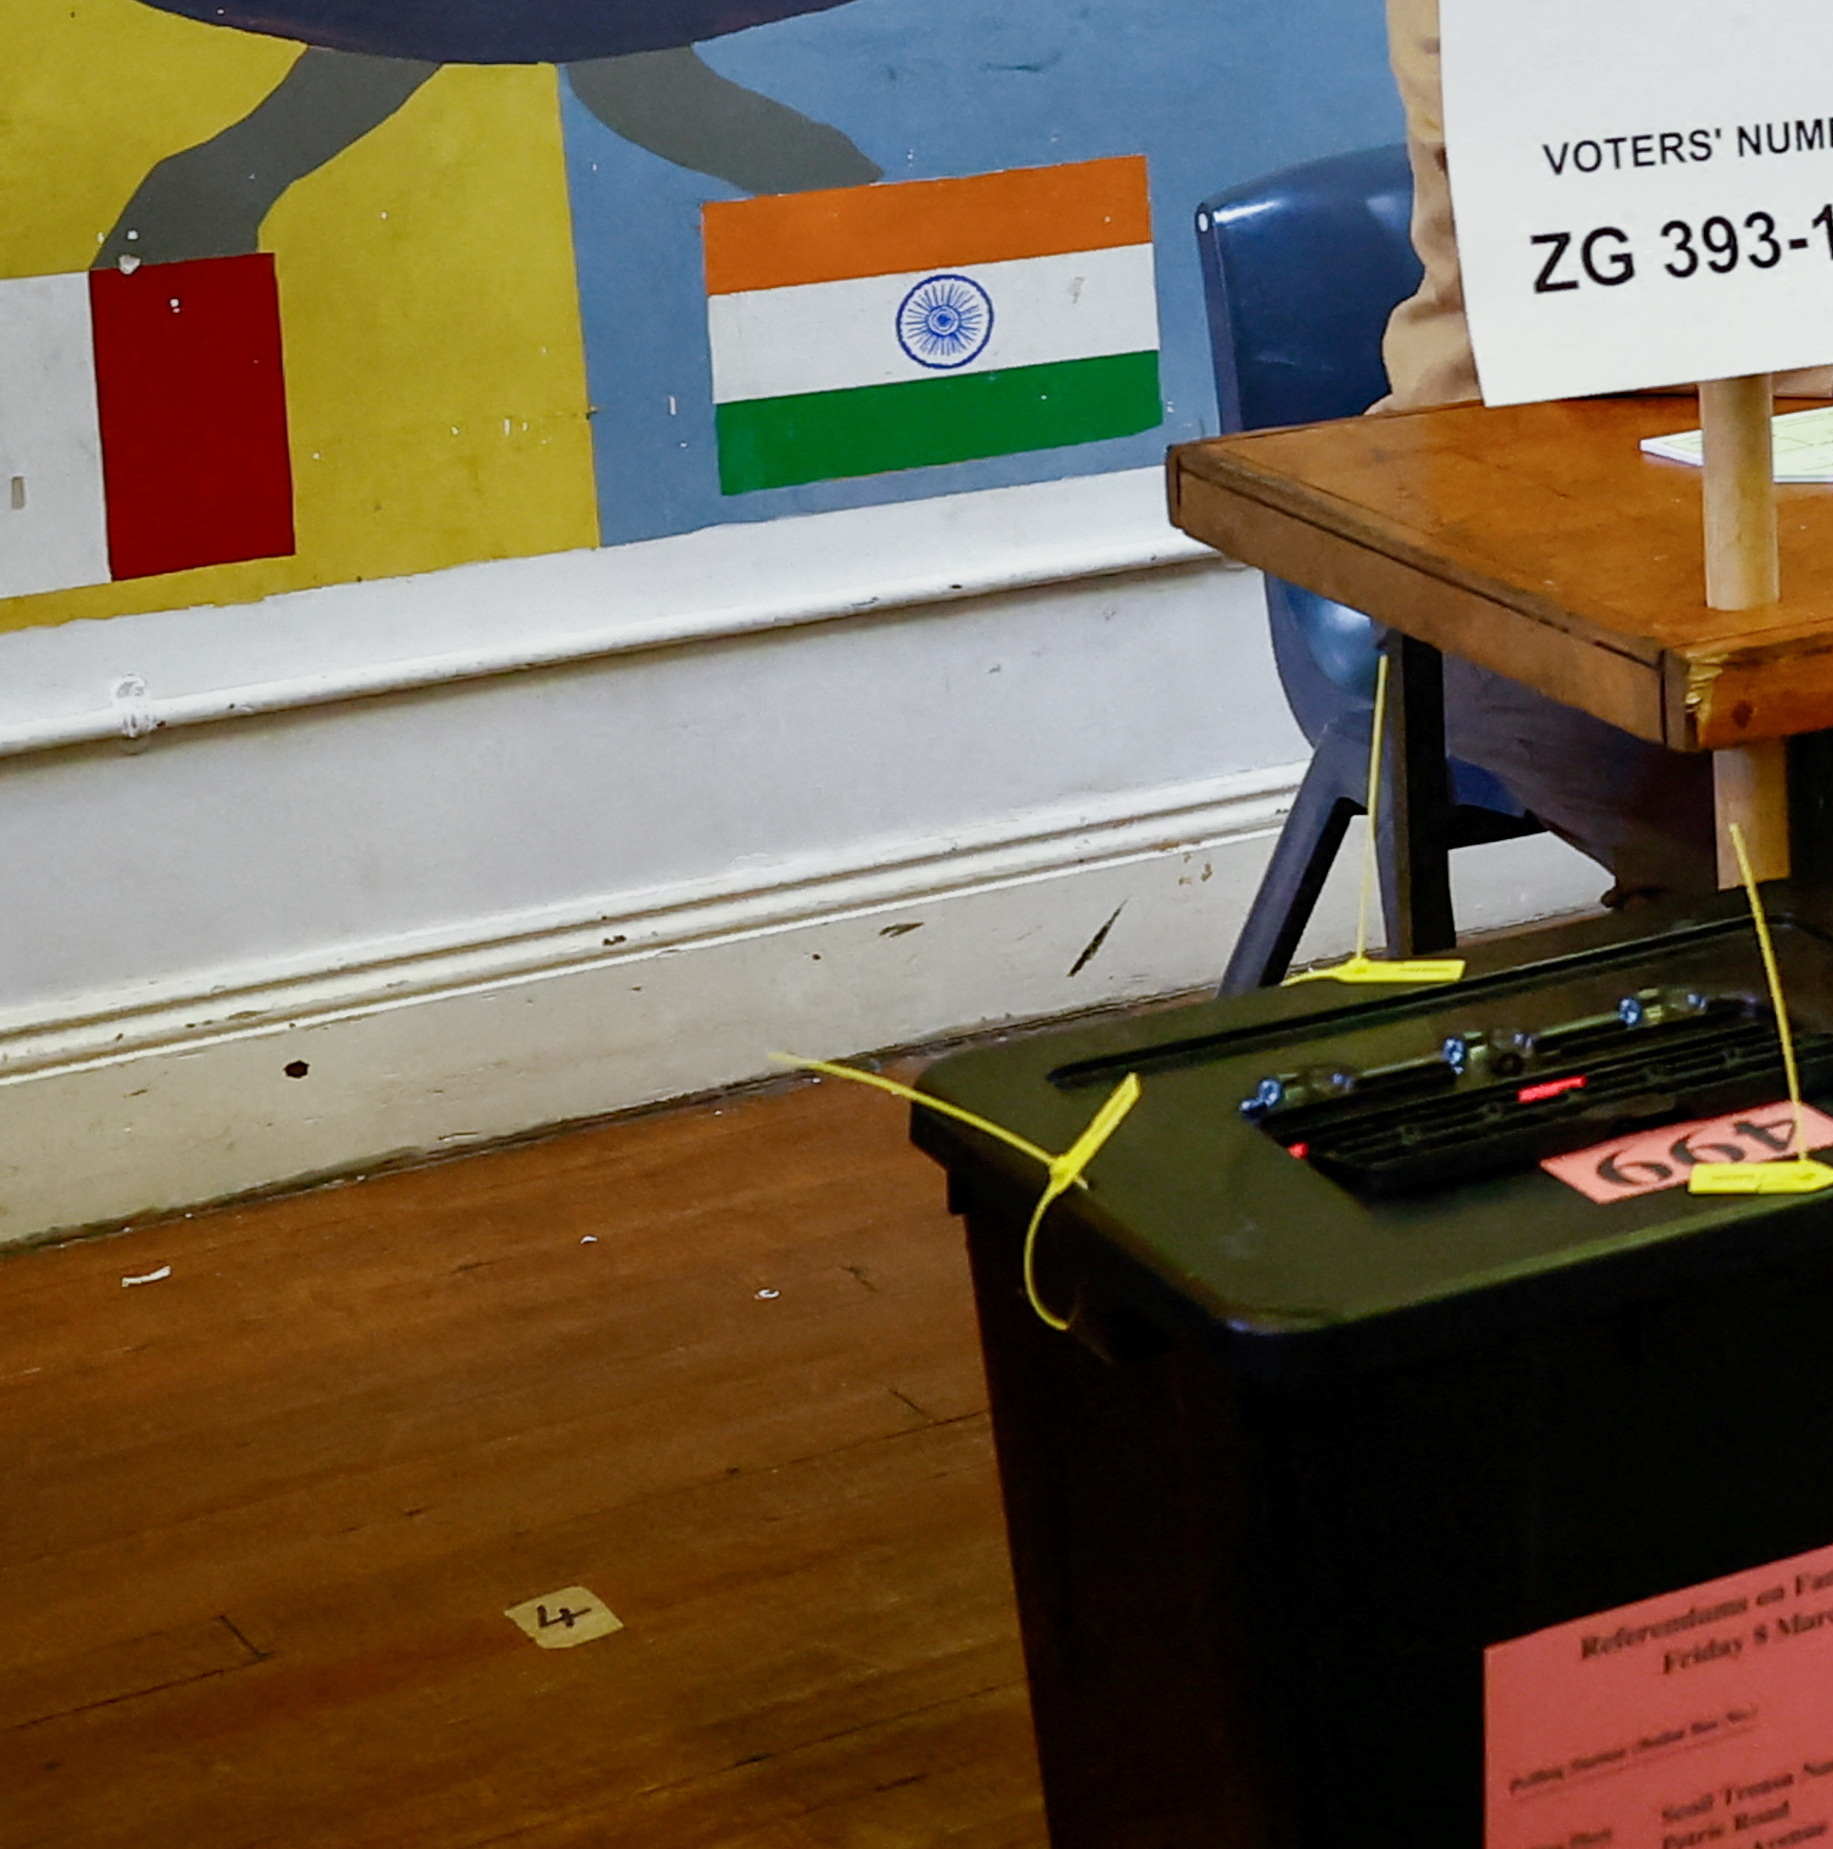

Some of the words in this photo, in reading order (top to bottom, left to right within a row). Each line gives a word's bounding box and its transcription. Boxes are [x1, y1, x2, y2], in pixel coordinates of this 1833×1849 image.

[1542, 127, 1723, 177] VOTERS'
[1530, 226, 1636, 294] ZG
[1756, 1584, 1785, 1607] on
[1662, 1637, 1744, 1675] Friday
[1735, 1800, 1791, 1832] Road
